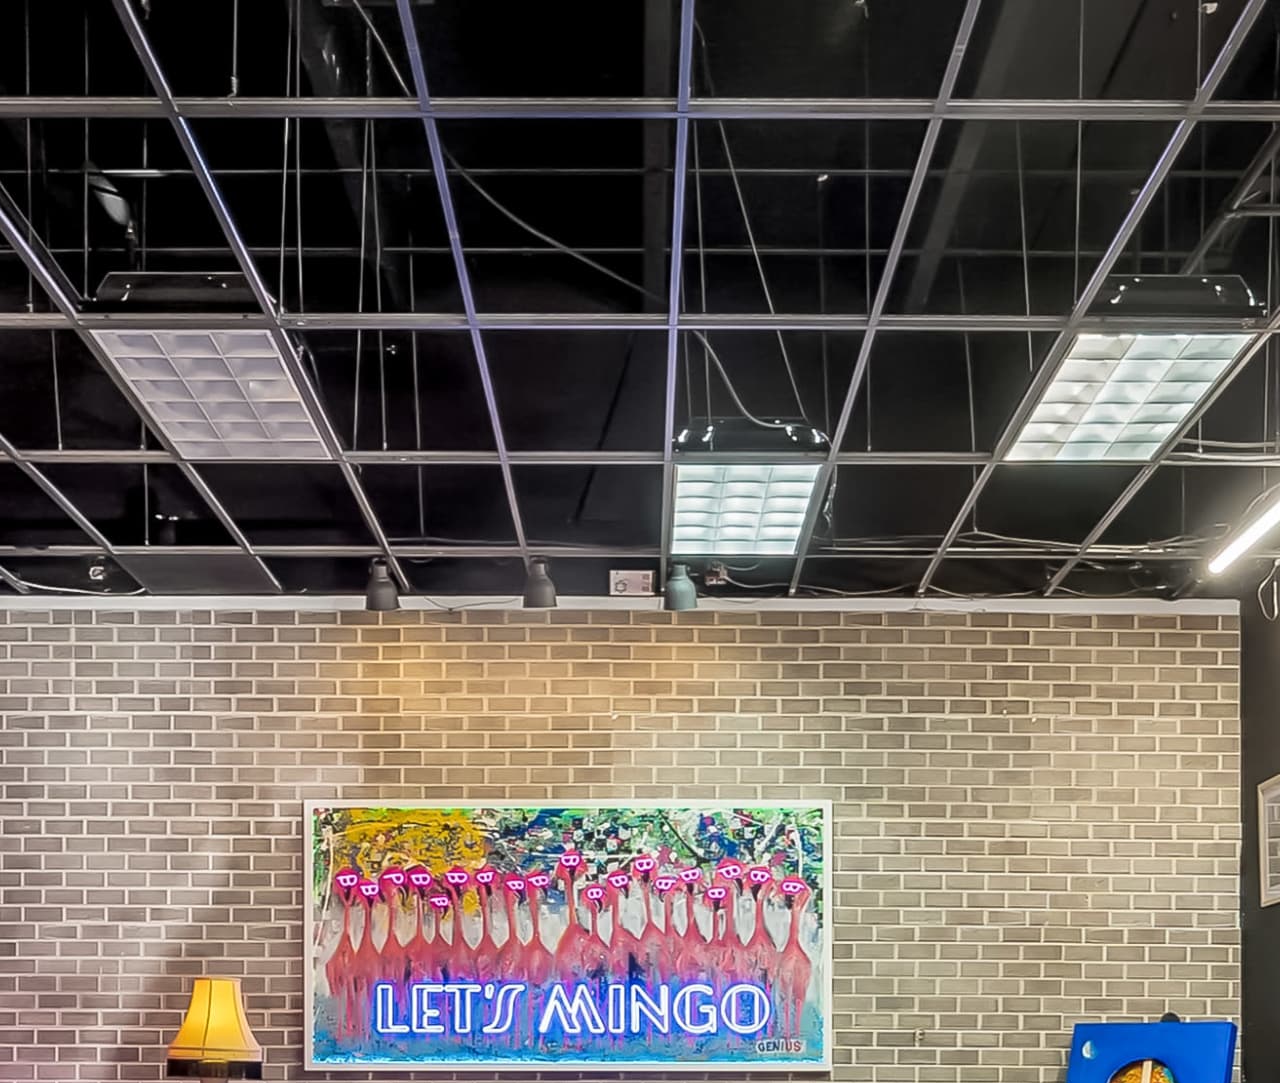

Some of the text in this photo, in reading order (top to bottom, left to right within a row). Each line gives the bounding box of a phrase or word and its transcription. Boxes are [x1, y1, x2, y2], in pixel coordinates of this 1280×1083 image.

[376, 982, 775, 1036] LET'S MINGO
[758, 1040, 801, 1052] GENIUS
